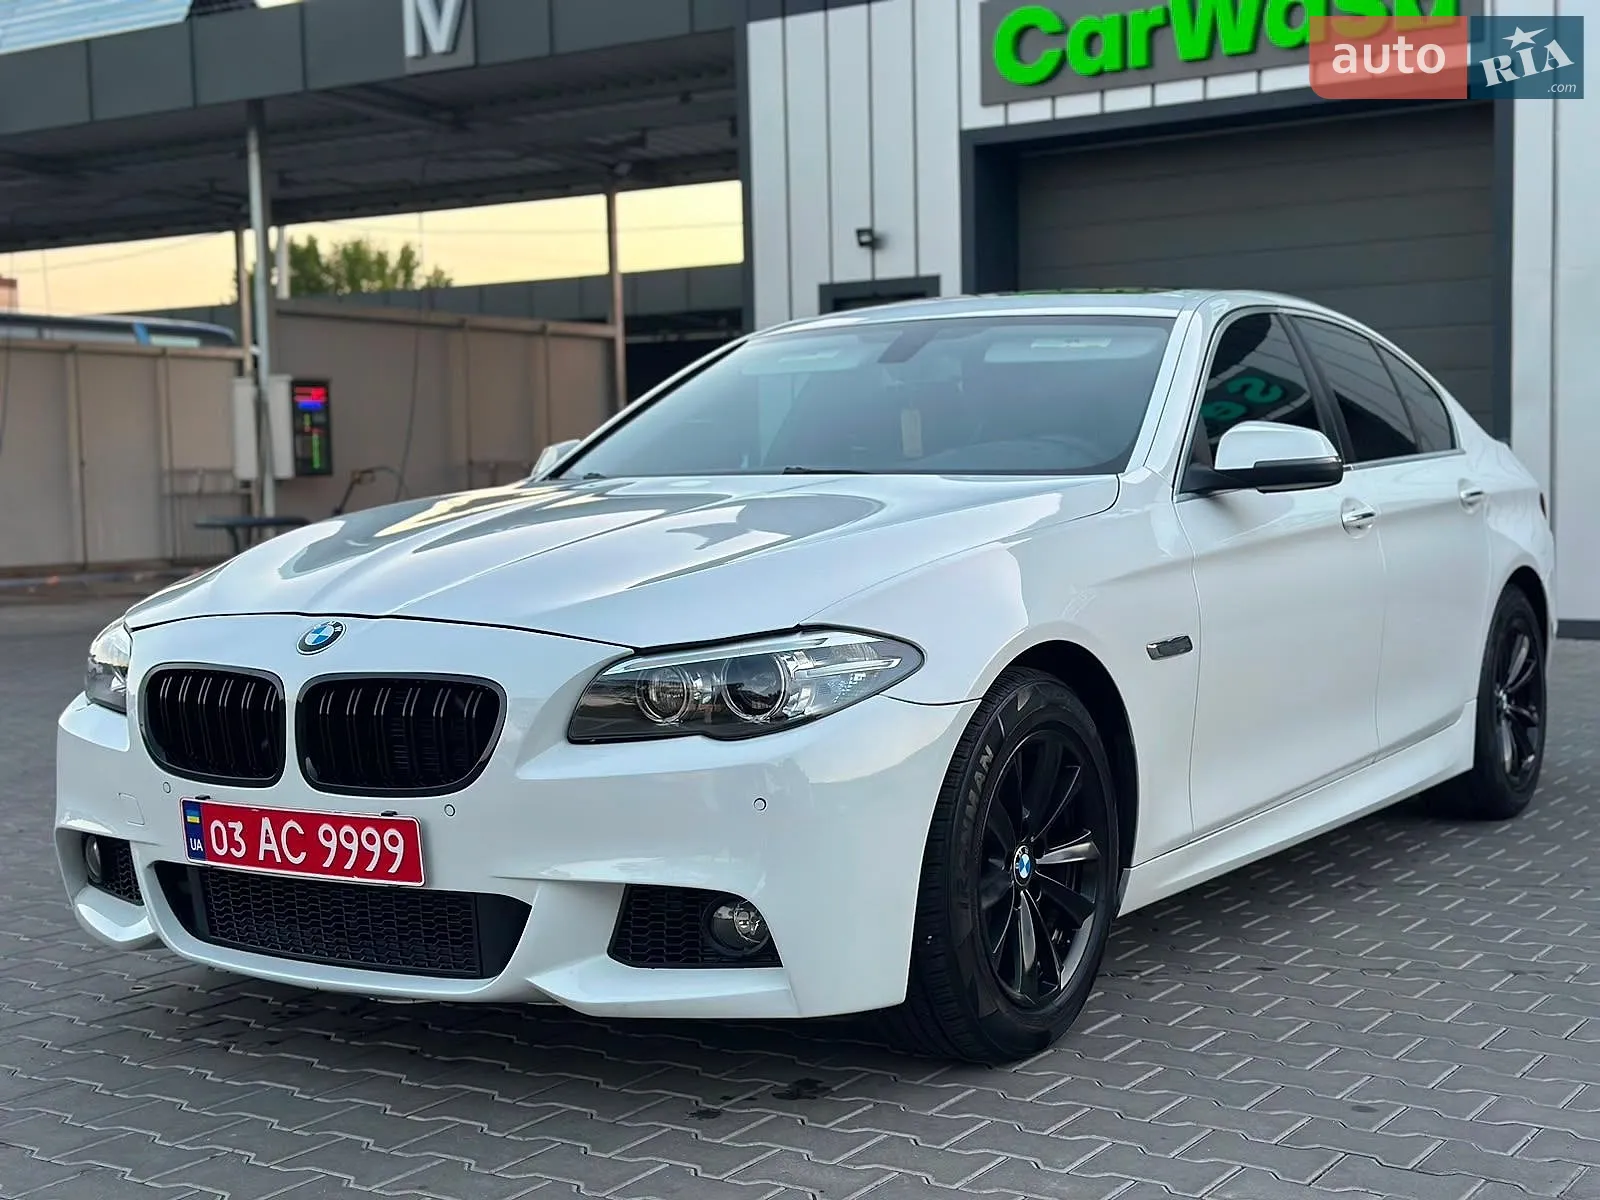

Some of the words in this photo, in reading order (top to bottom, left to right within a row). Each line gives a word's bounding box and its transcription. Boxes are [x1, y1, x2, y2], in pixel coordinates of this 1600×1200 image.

[189, 838, 203, 851] UA
[210, 819, 247, 858] 03
[258, 816, 307, 865] AC
[317, 823, 405, 873] 9999
